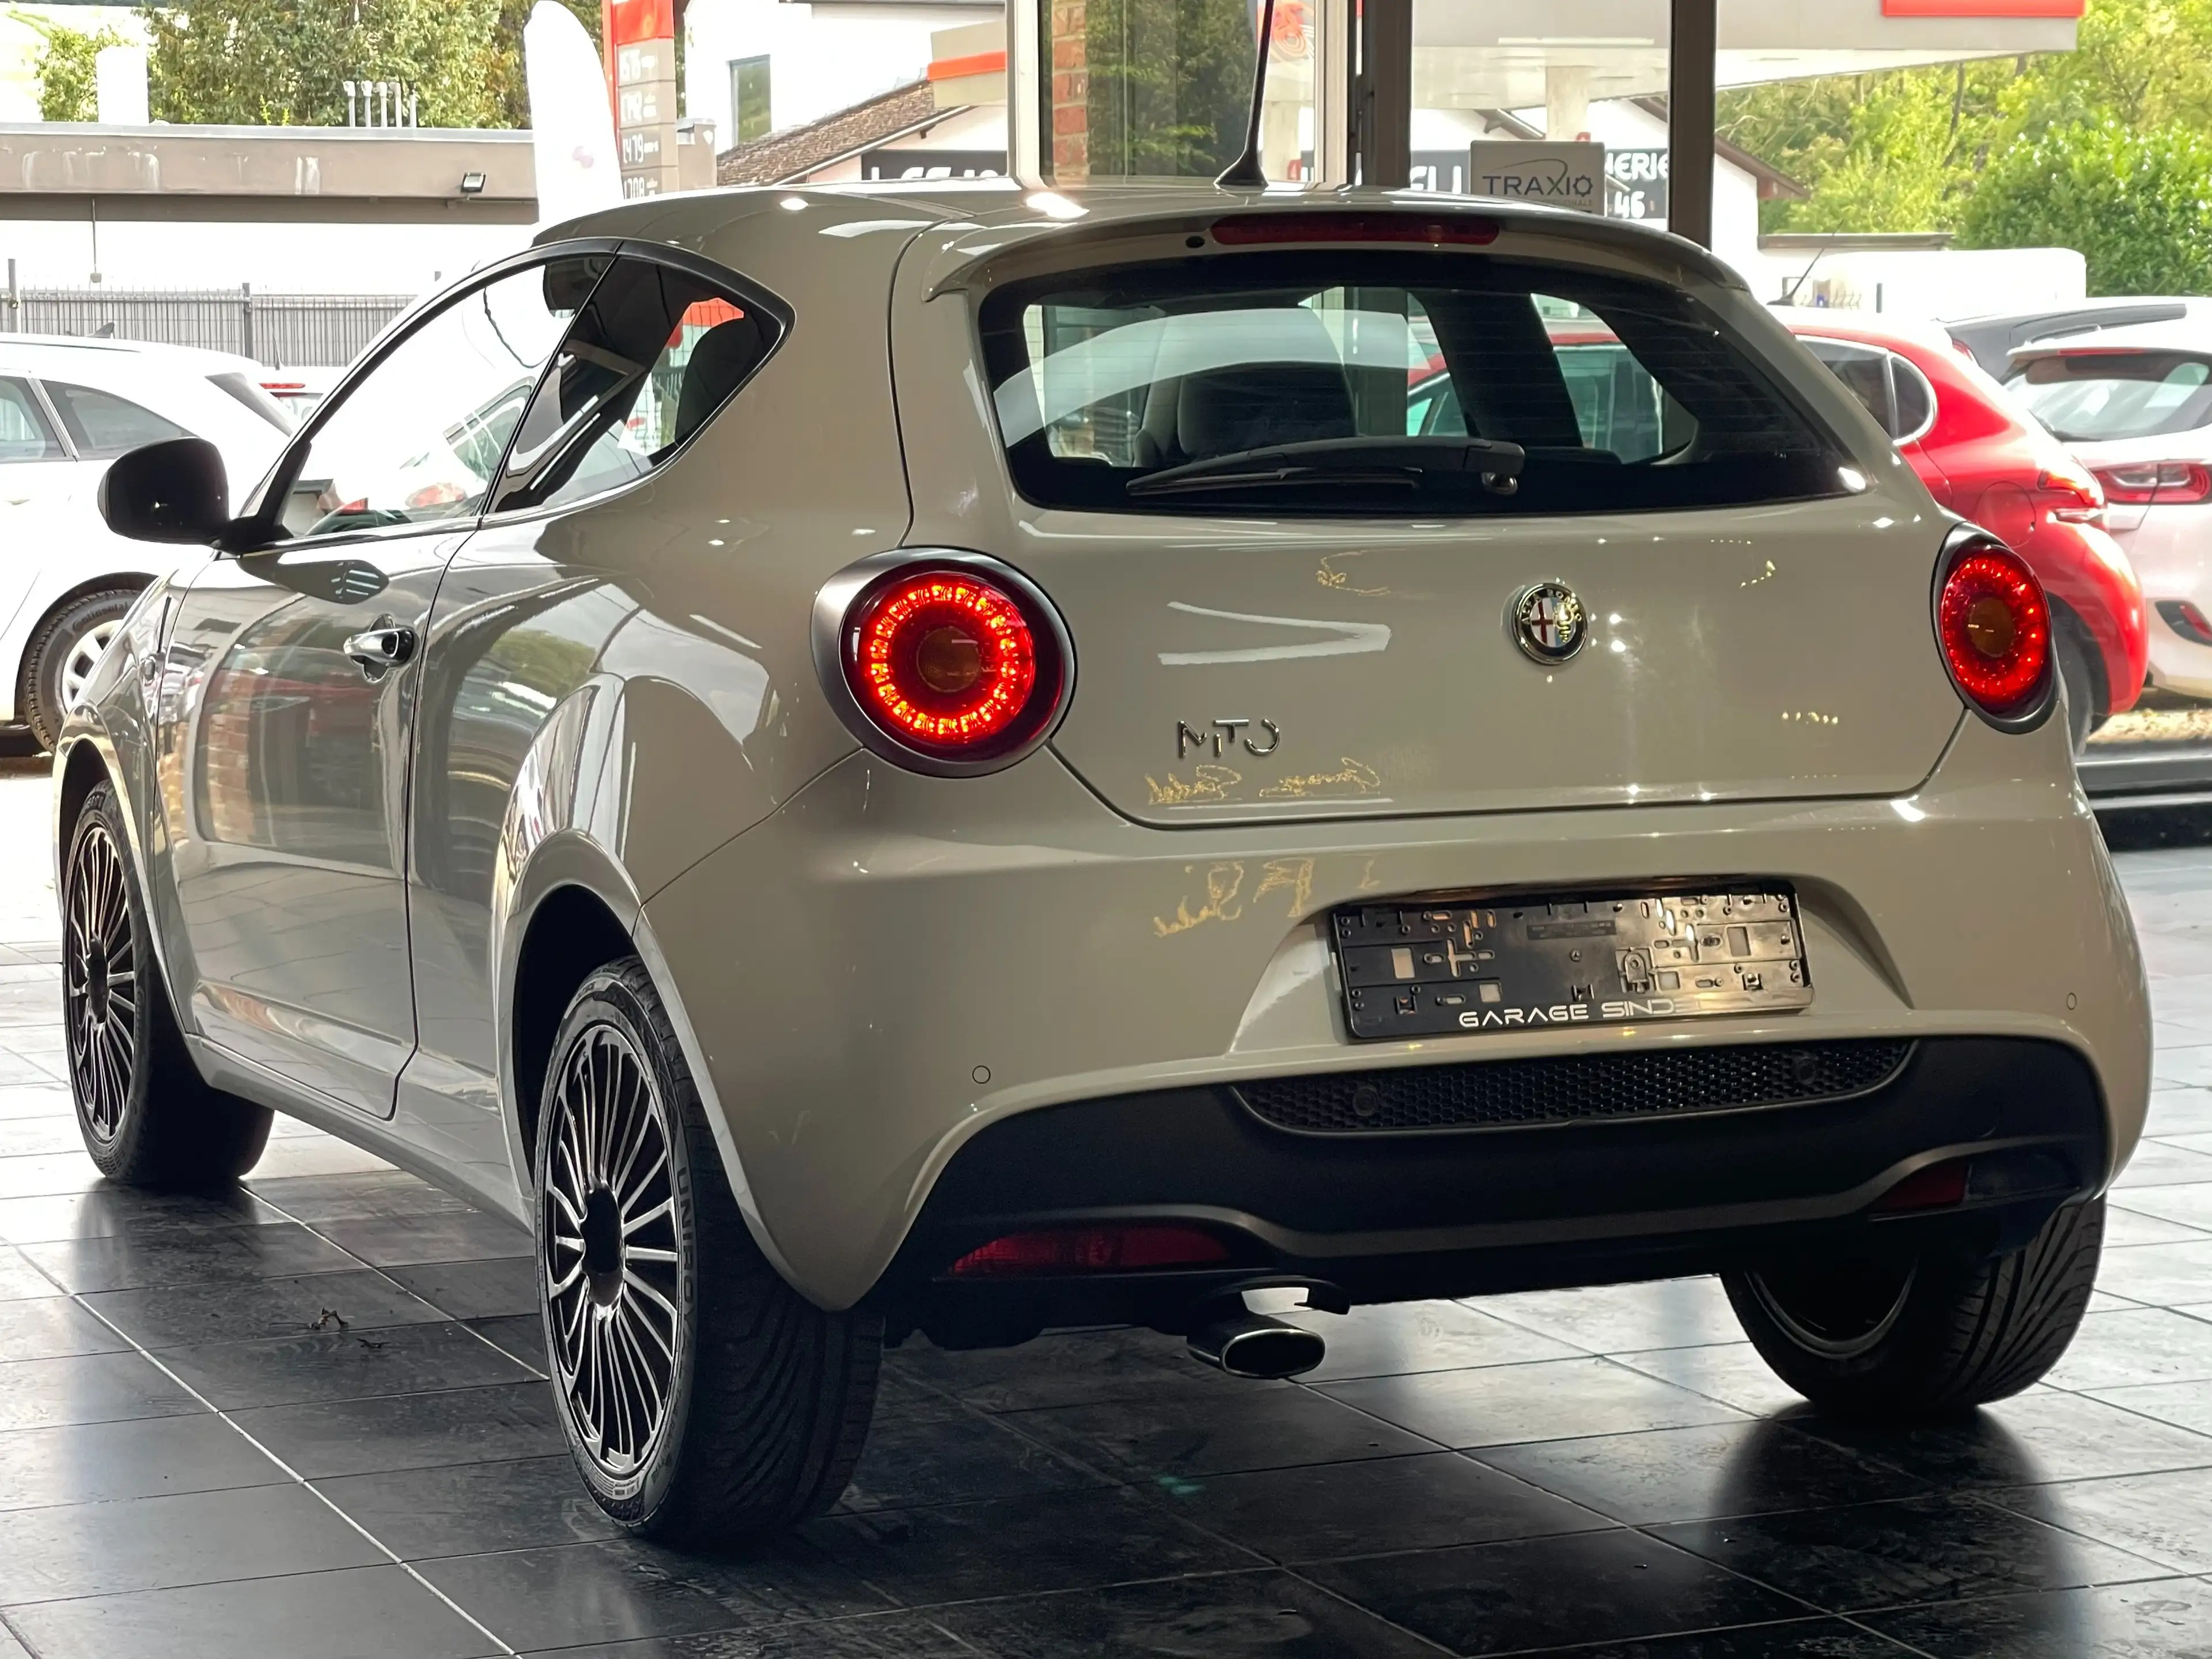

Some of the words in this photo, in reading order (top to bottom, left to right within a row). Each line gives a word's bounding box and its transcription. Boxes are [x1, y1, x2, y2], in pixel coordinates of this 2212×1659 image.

[1482, 174, 1593, 198] TRAXIO
[1614, 191, 1645, 219] 46
[1459, 1004, 1589, 1028] GARAGE
